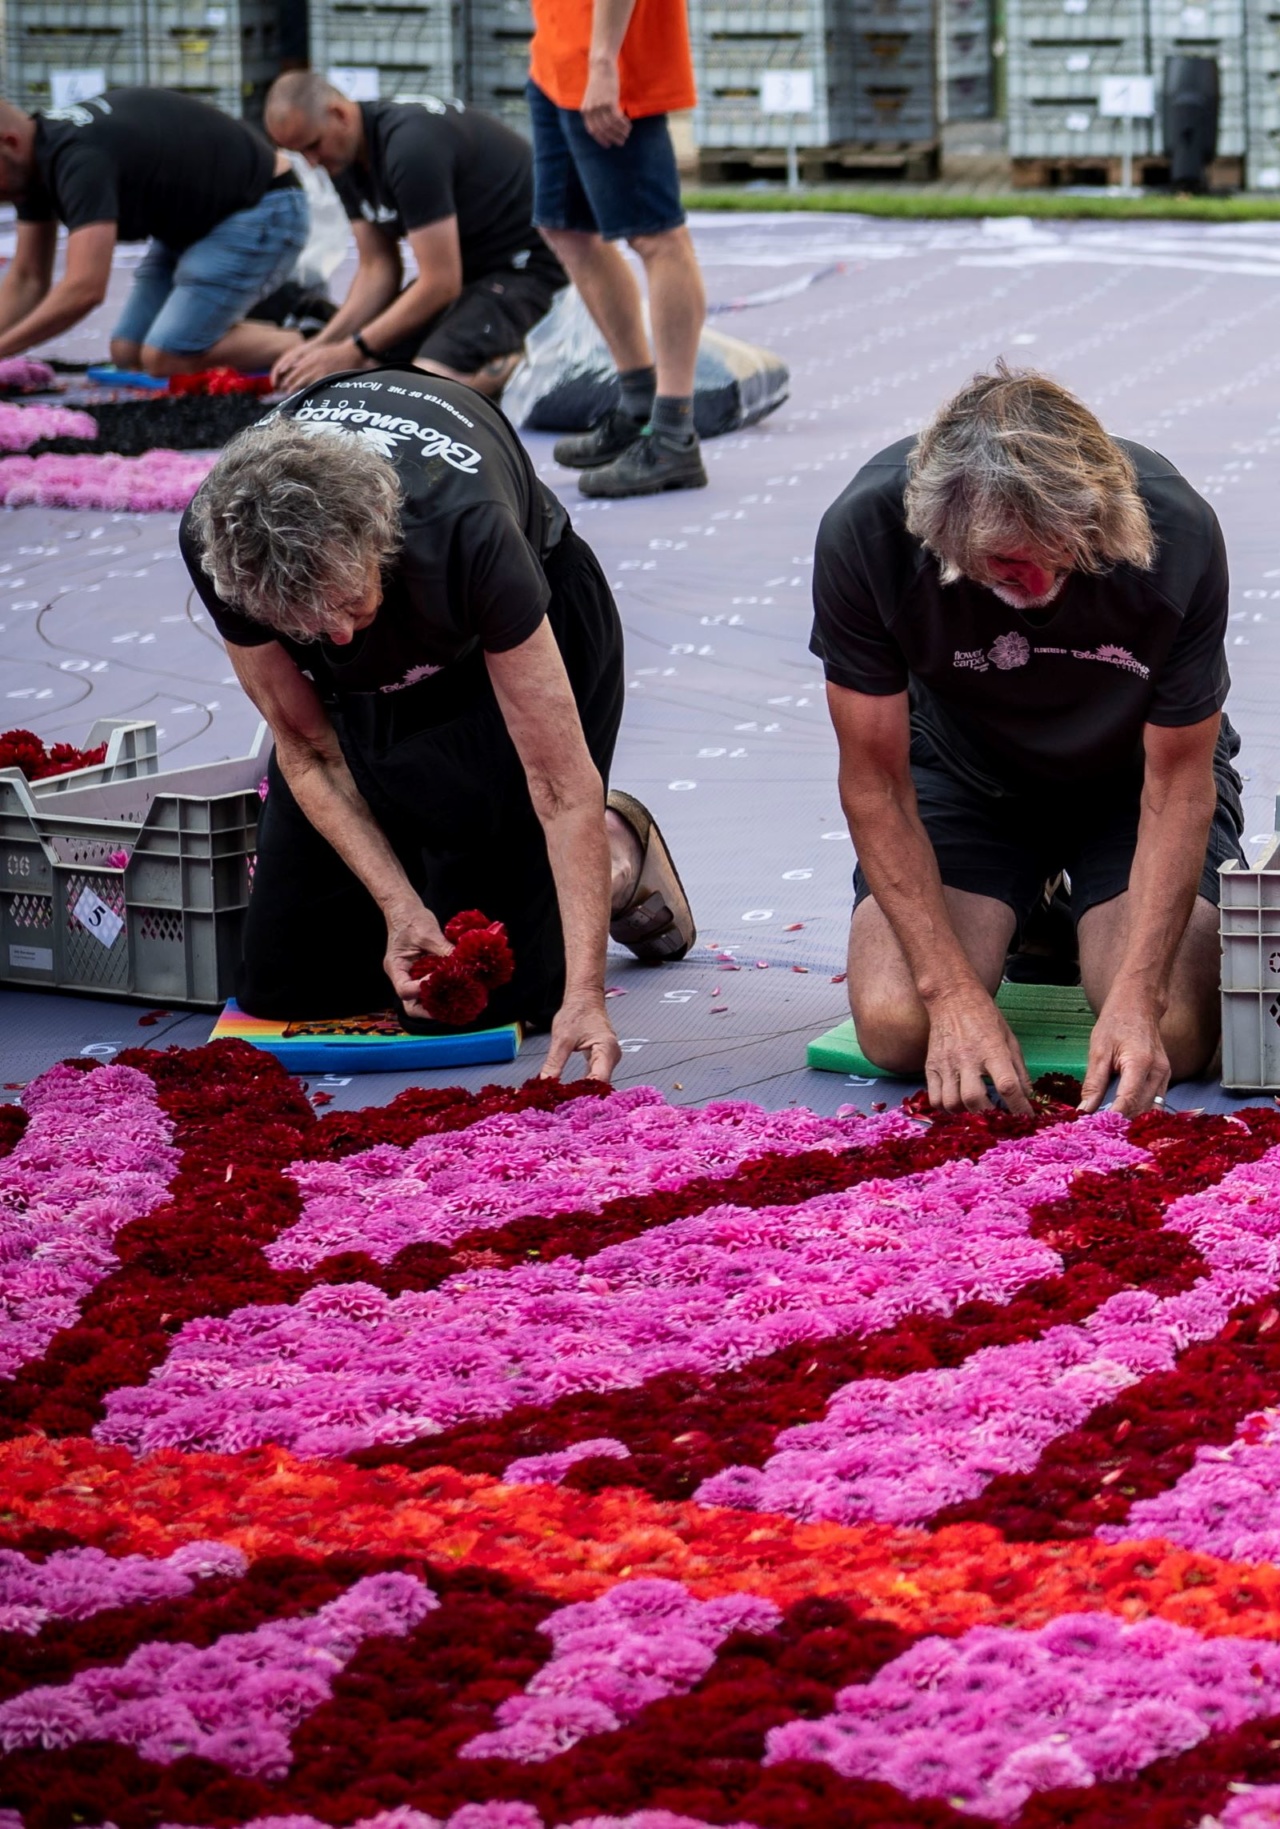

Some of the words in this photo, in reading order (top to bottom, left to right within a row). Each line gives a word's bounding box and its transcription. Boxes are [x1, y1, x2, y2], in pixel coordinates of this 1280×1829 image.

[387, 385, 407, 396] THE
[408, 390, 422, 400] OF
[422, 391, 474, 428] SUPPORTER
[954, 648, 983, 660] flower
[1033, 646, 1061, 654] FLOWERED
[953, 654, 986, 669] carpet
[7, 854, 31, 877] 06
[88, 906, 106, 927] 5
[659, 988, 699, 1004] 5
